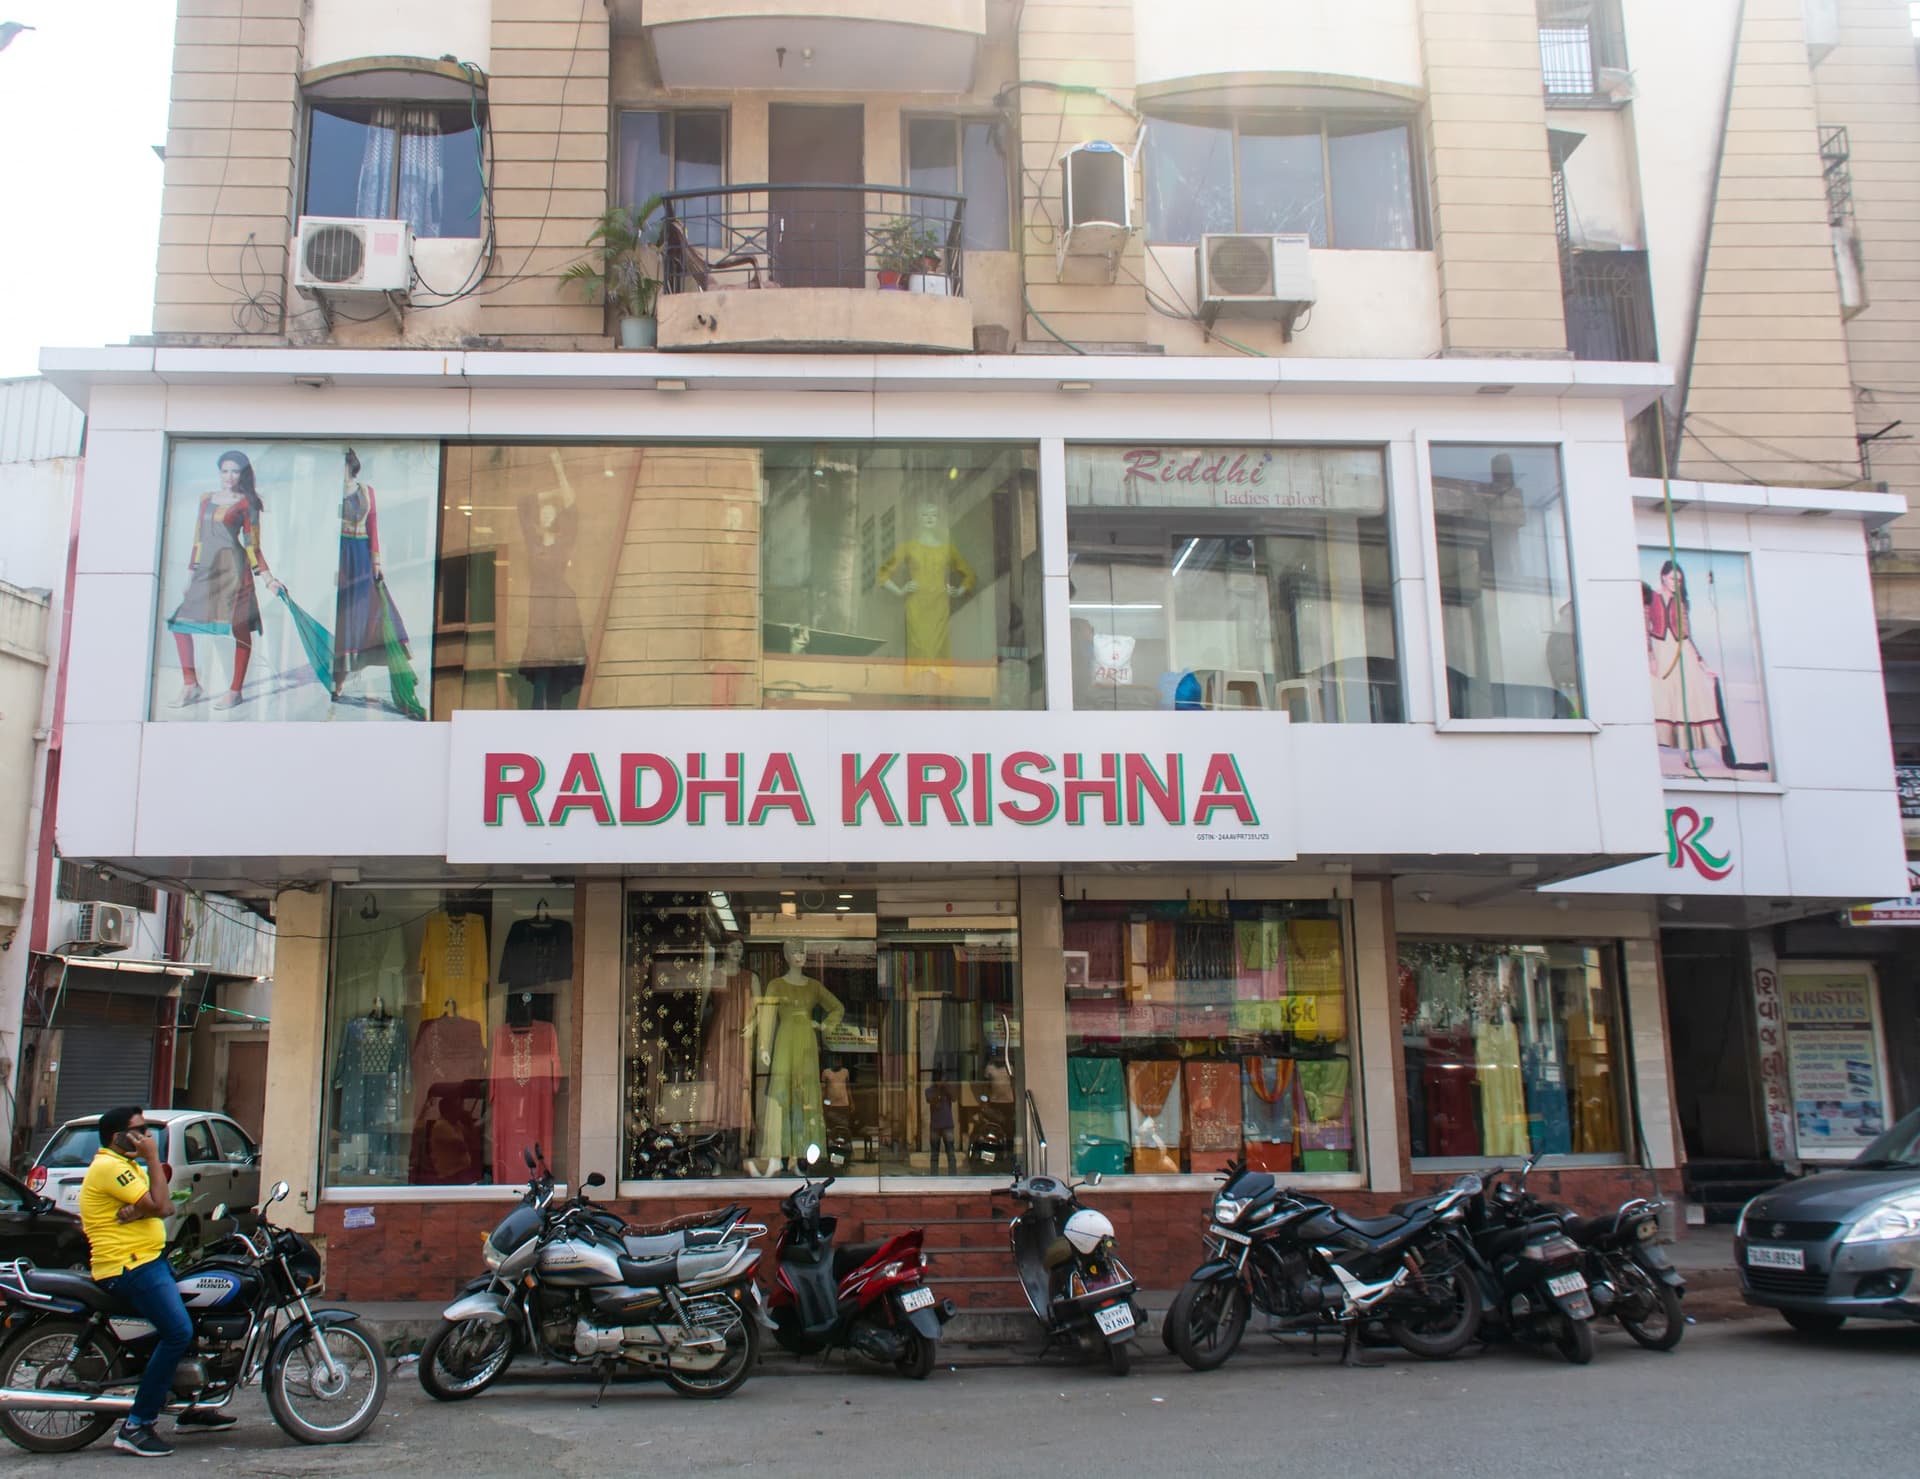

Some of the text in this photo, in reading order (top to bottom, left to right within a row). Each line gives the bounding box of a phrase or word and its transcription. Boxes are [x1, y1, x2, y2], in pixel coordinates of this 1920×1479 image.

[1123, 449, 1272, 486] Riddhi
[1224, 489, 1270, 505] ladies
[484, 750, 1261, 827] RADHA KRISHNA
[1791, 1007, 1867, 1019] TRAVELS
[116, 1169, 136, 1187] 03
[1104, 1315, 1130, 1330] 8180
